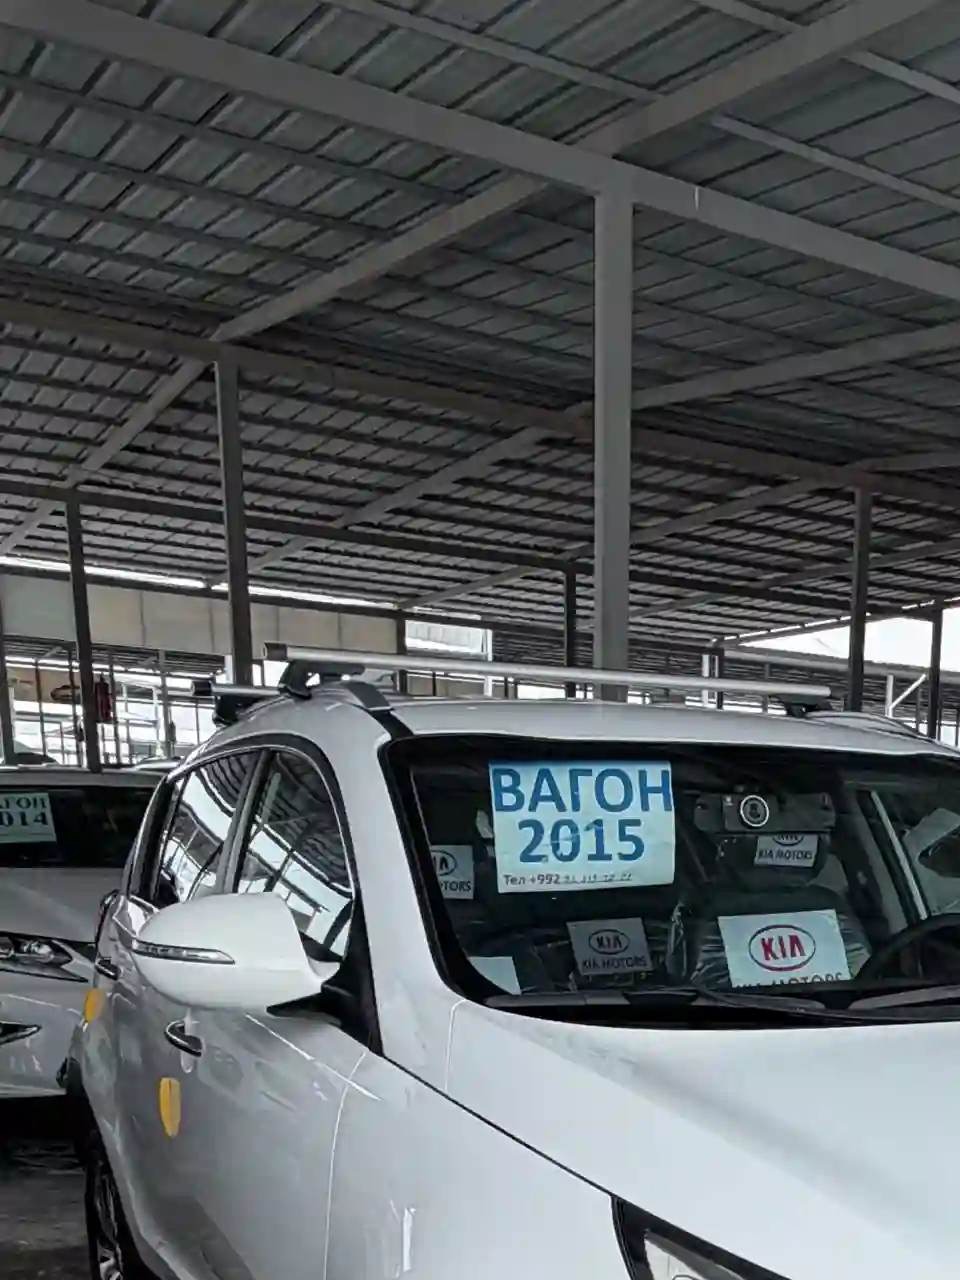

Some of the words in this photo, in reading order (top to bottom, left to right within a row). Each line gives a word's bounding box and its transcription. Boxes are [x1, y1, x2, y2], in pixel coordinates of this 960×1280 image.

[491, 767, 673, 813] ВАГОН
[518, 818, 645, 863] 2015
[440, 880, 472, 892] TORS
[530, 873, 561, 886] +992
[761, 934, 806, 961] KIA
